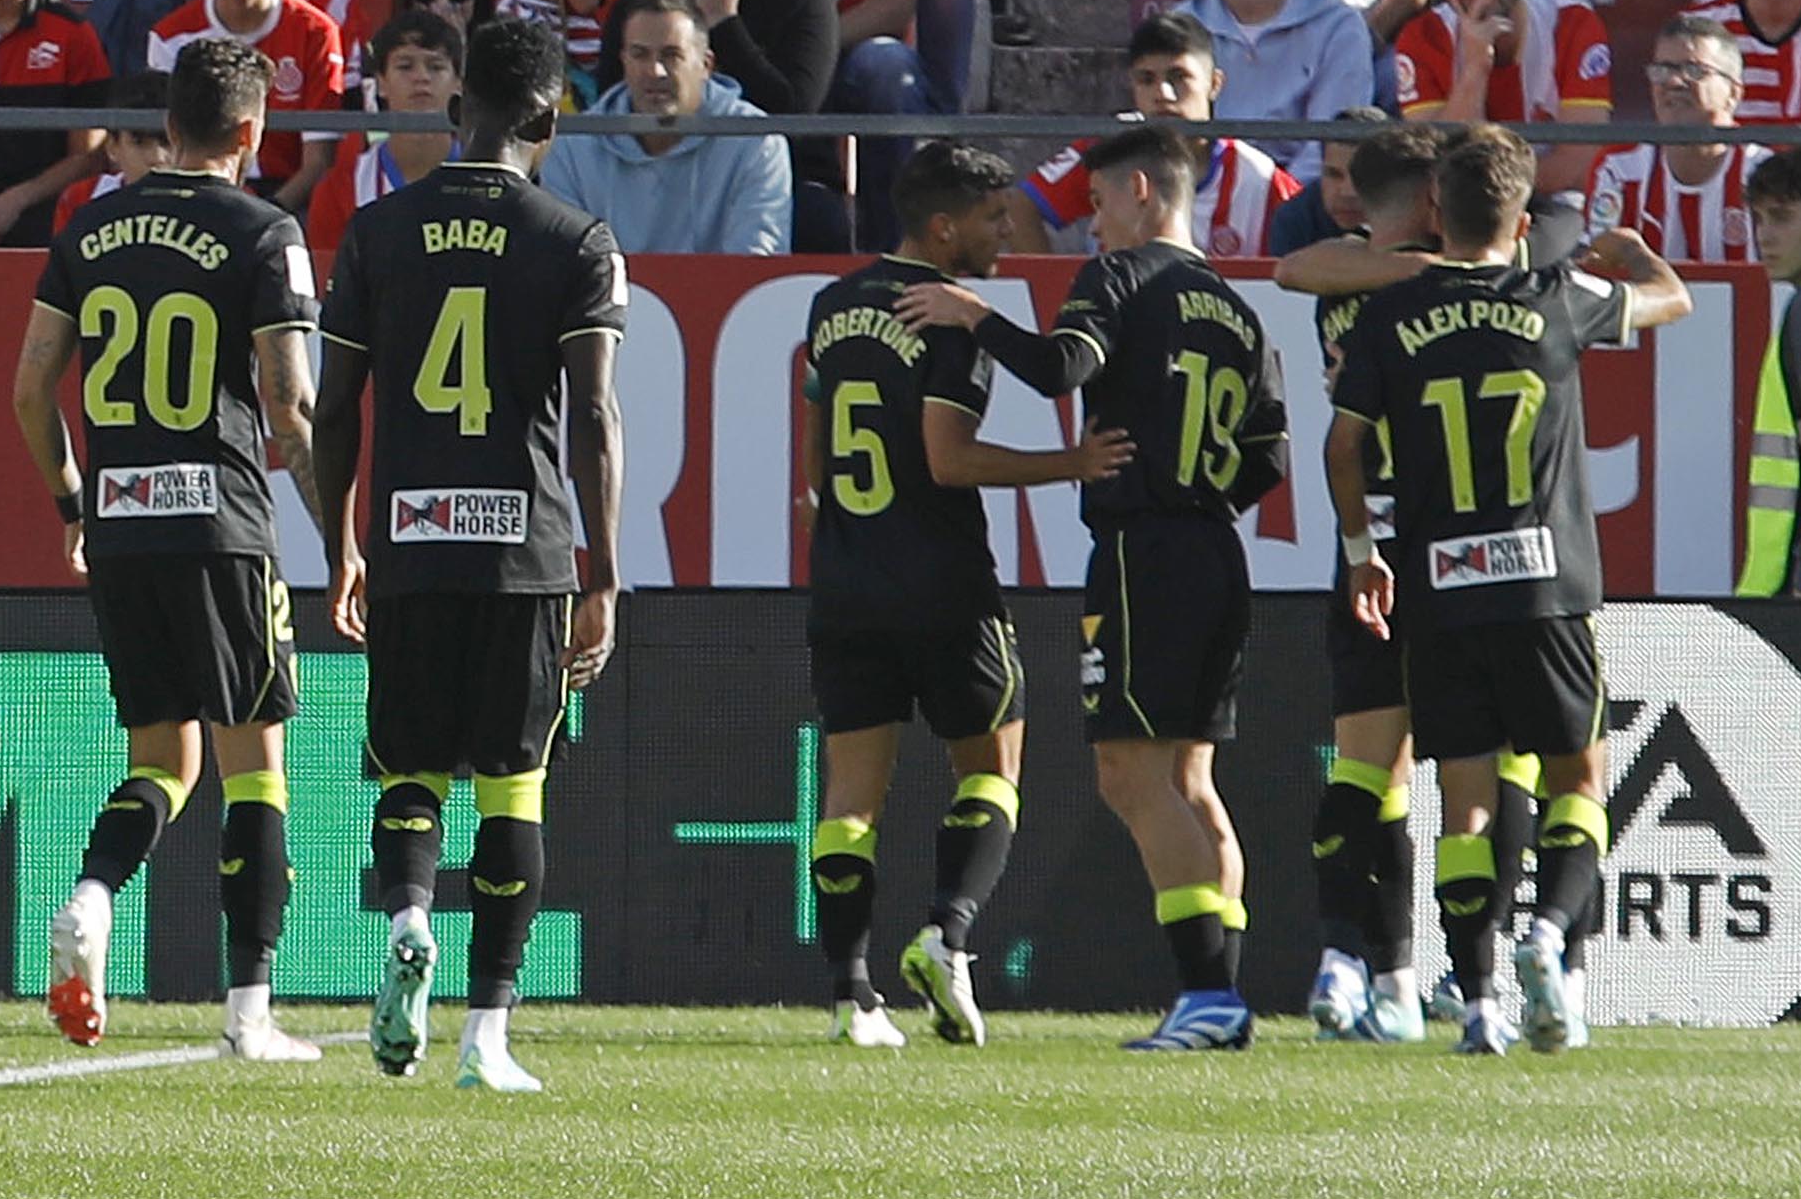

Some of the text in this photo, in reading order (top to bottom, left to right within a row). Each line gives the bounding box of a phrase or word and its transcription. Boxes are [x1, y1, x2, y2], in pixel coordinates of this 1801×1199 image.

[79, 214, 230, 272] CENTELLES
[421, 219, 508, 256] BABA
[812, 306, 928, 368] ROBERTONE
[1176, 290, 1257, 352] ARRIBAS
[1470, 299, 1546, 343] POZO
[79, 285, 219, 432] 20
[413, 286, 492, 437] 4
[831, 379, 896, 517] 5
[1175, 350, 1249, 491] 19
[1421, 368, 1547, 513] 17
[151, 487, 213, 510] HORSE
[153, 470, 211, 489] POWER
[454, 495, 522, 514] POWER
[454, 513, 524, 536] HORSE
